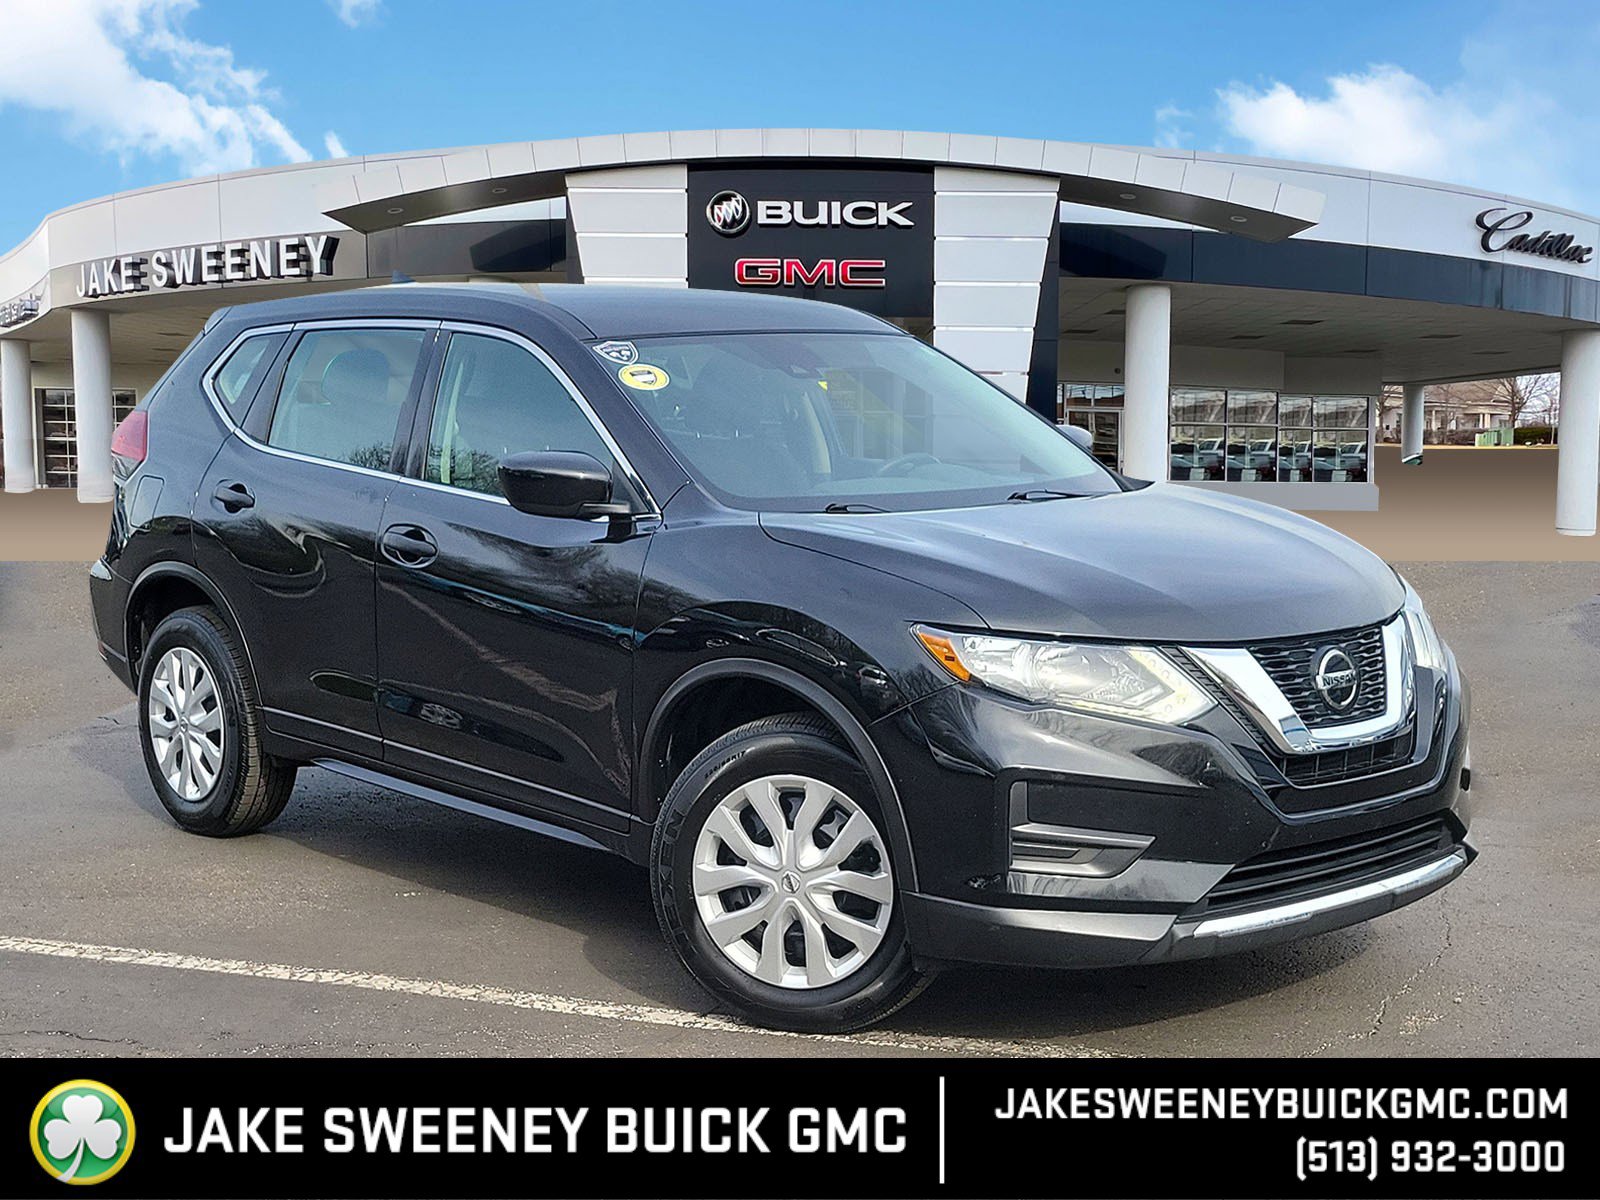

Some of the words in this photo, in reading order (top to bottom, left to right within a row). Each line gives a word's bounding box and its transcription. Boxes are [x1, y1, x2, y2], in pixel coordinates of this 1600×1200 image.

[757, 200, 915, 226] BUICK
[1475, 207, 1593, 263] Cadillac
[76, 256, 140, 298] JAKE
[152, 235, 333, 288] SWEENEY
[734, 258, 886, 287] GMC
